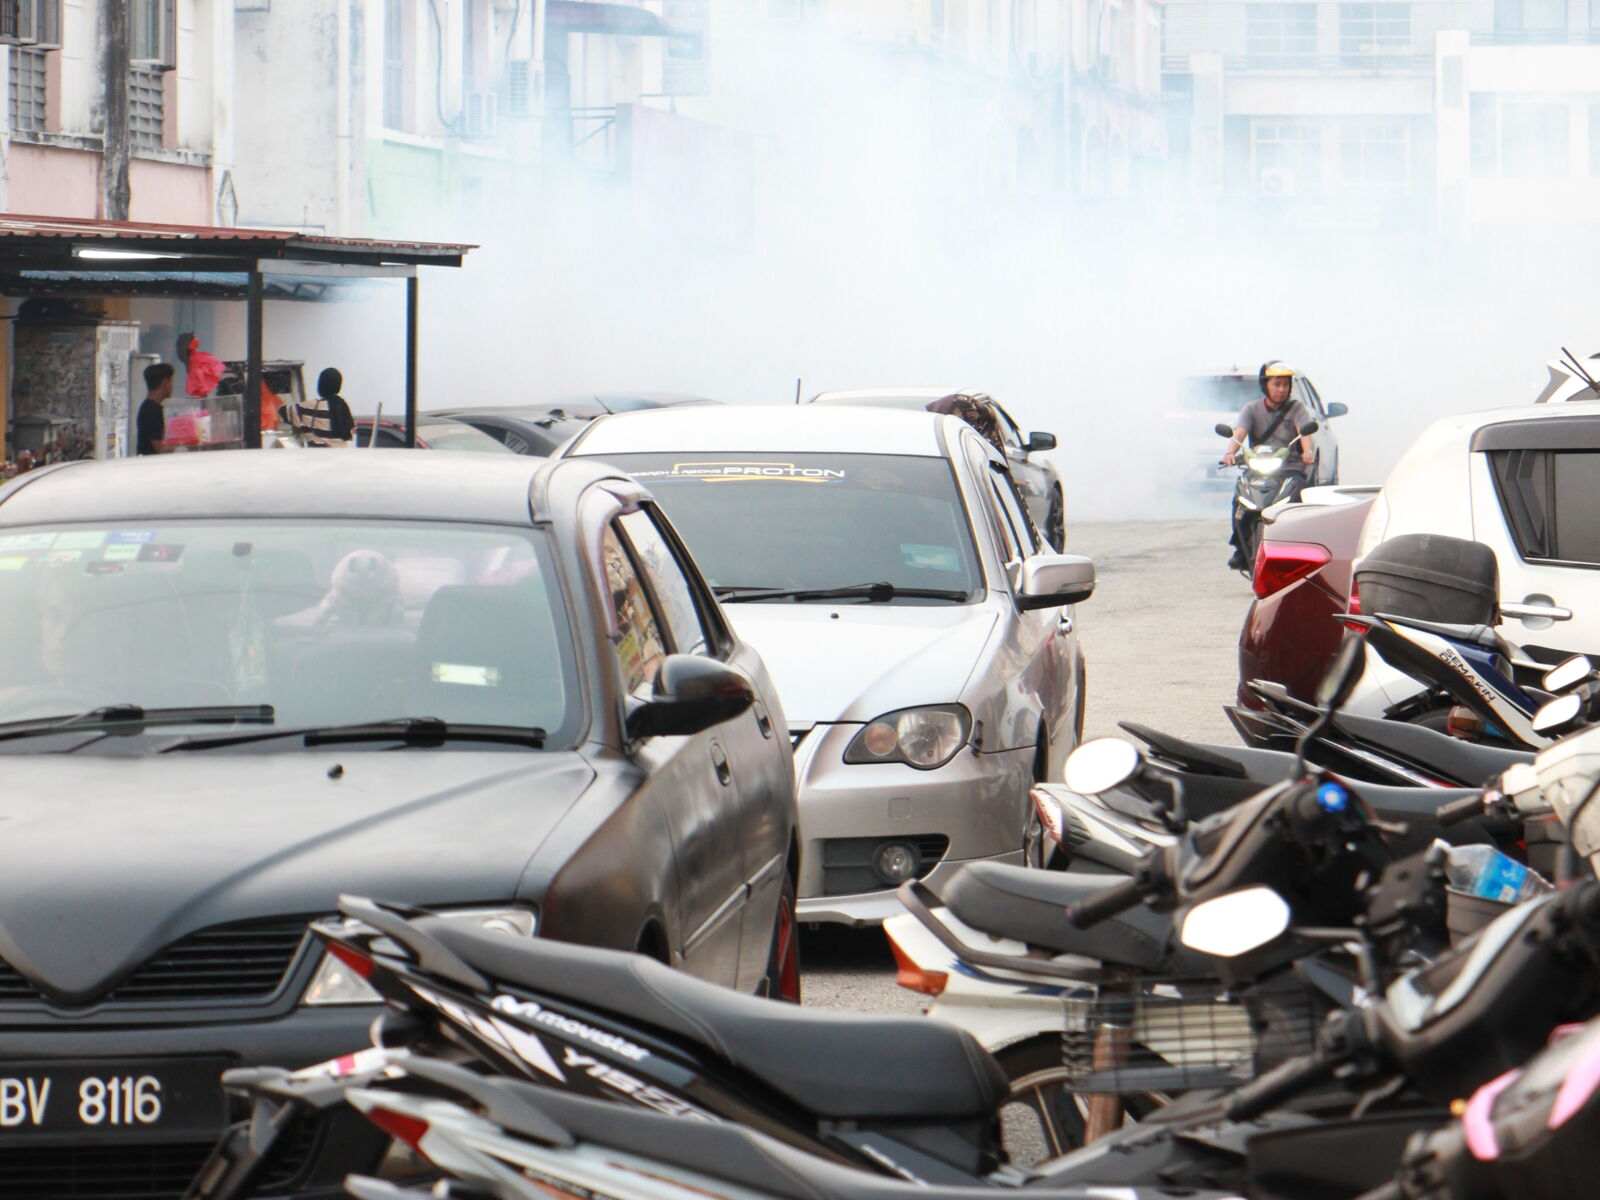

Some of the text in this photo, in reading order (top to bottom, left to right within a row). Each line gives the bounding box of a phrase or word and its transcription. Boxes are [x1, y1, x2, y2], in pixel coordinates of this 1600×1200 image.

[723, 466, 845, 478] PROTON
[1444, 648, 1496, 701] SEMAKIN
[535, 1009, 651, 1062] movistar
[79, 1075, 162, 1125] 8116
